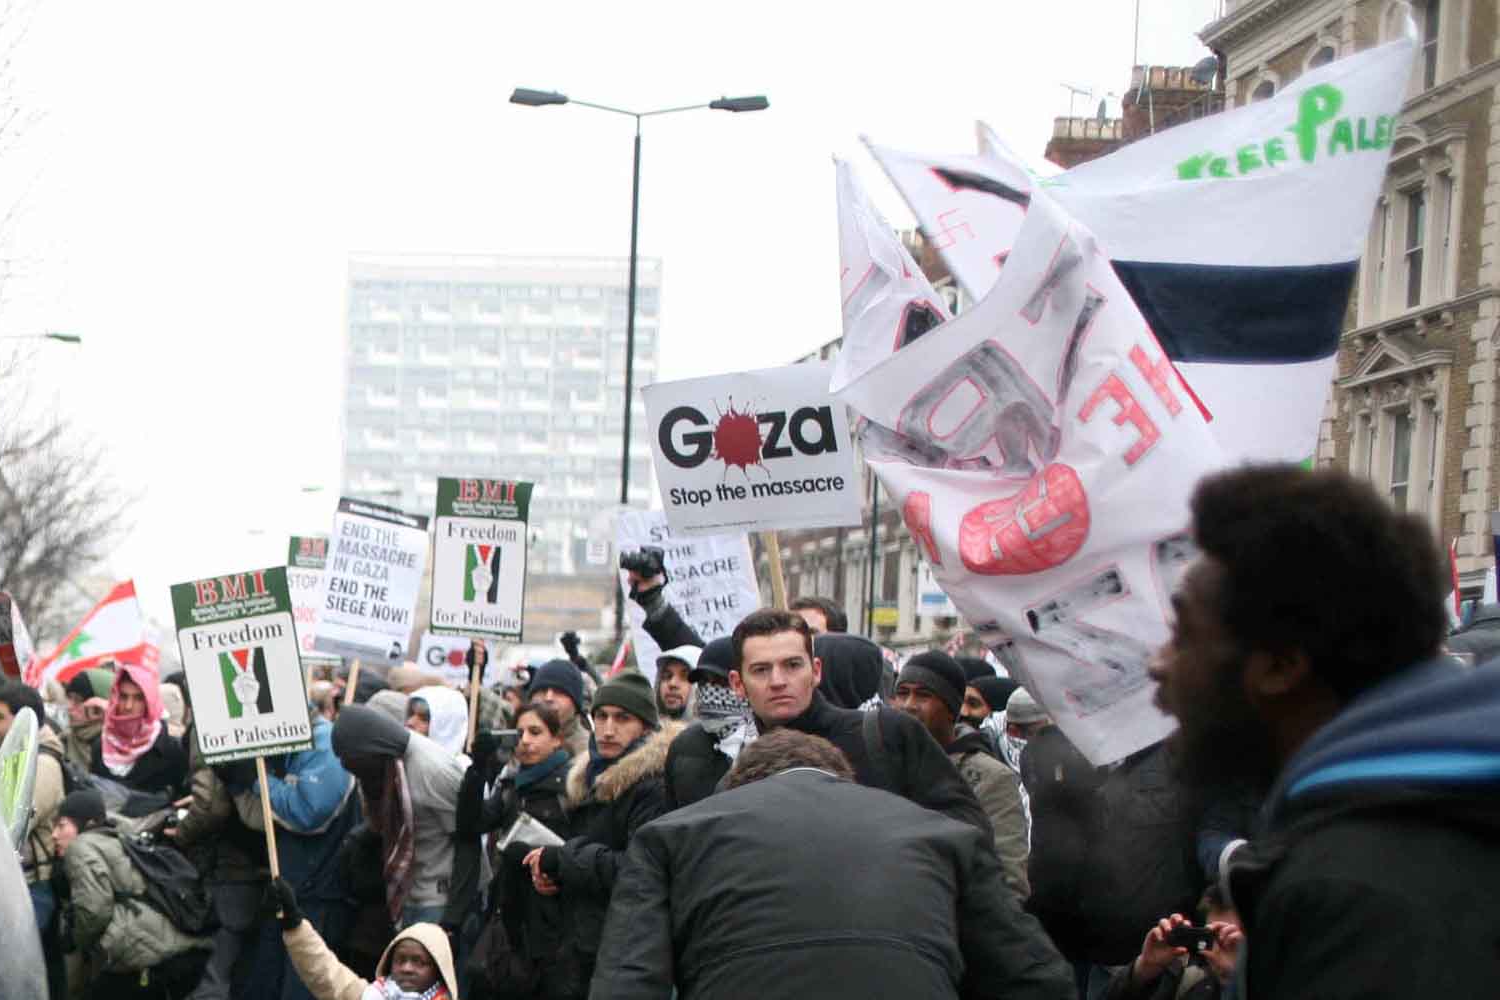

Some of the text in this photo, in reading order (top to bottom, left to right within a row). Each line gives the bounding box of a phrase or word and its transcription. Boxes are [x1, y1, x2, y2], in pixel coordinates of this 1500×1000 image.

[658, 403, 838, 469] Gza
[456, 479, 516, 504] BMI
[670, 475, 845, 507] Stop the massacre
[342, 520, 399, 546] END THE
[448, 522, 517, 542] Freedom
[338, 538, 418, 568] MASSACRE
[333, 555, 348, 573] IN
[352, 560, 389, 581] GAZA
[194, 570, 269, 606] BMI
[329, 576, 389, 601] END THE
[325, 594, 366, 616] SIEGE
[371, 602, 409, 625] NOW!
[435, 609, 519, 630] for Palestine
[192, 623, 284, 650] Freedom
[202, 720, 309, 750] for Palestine
